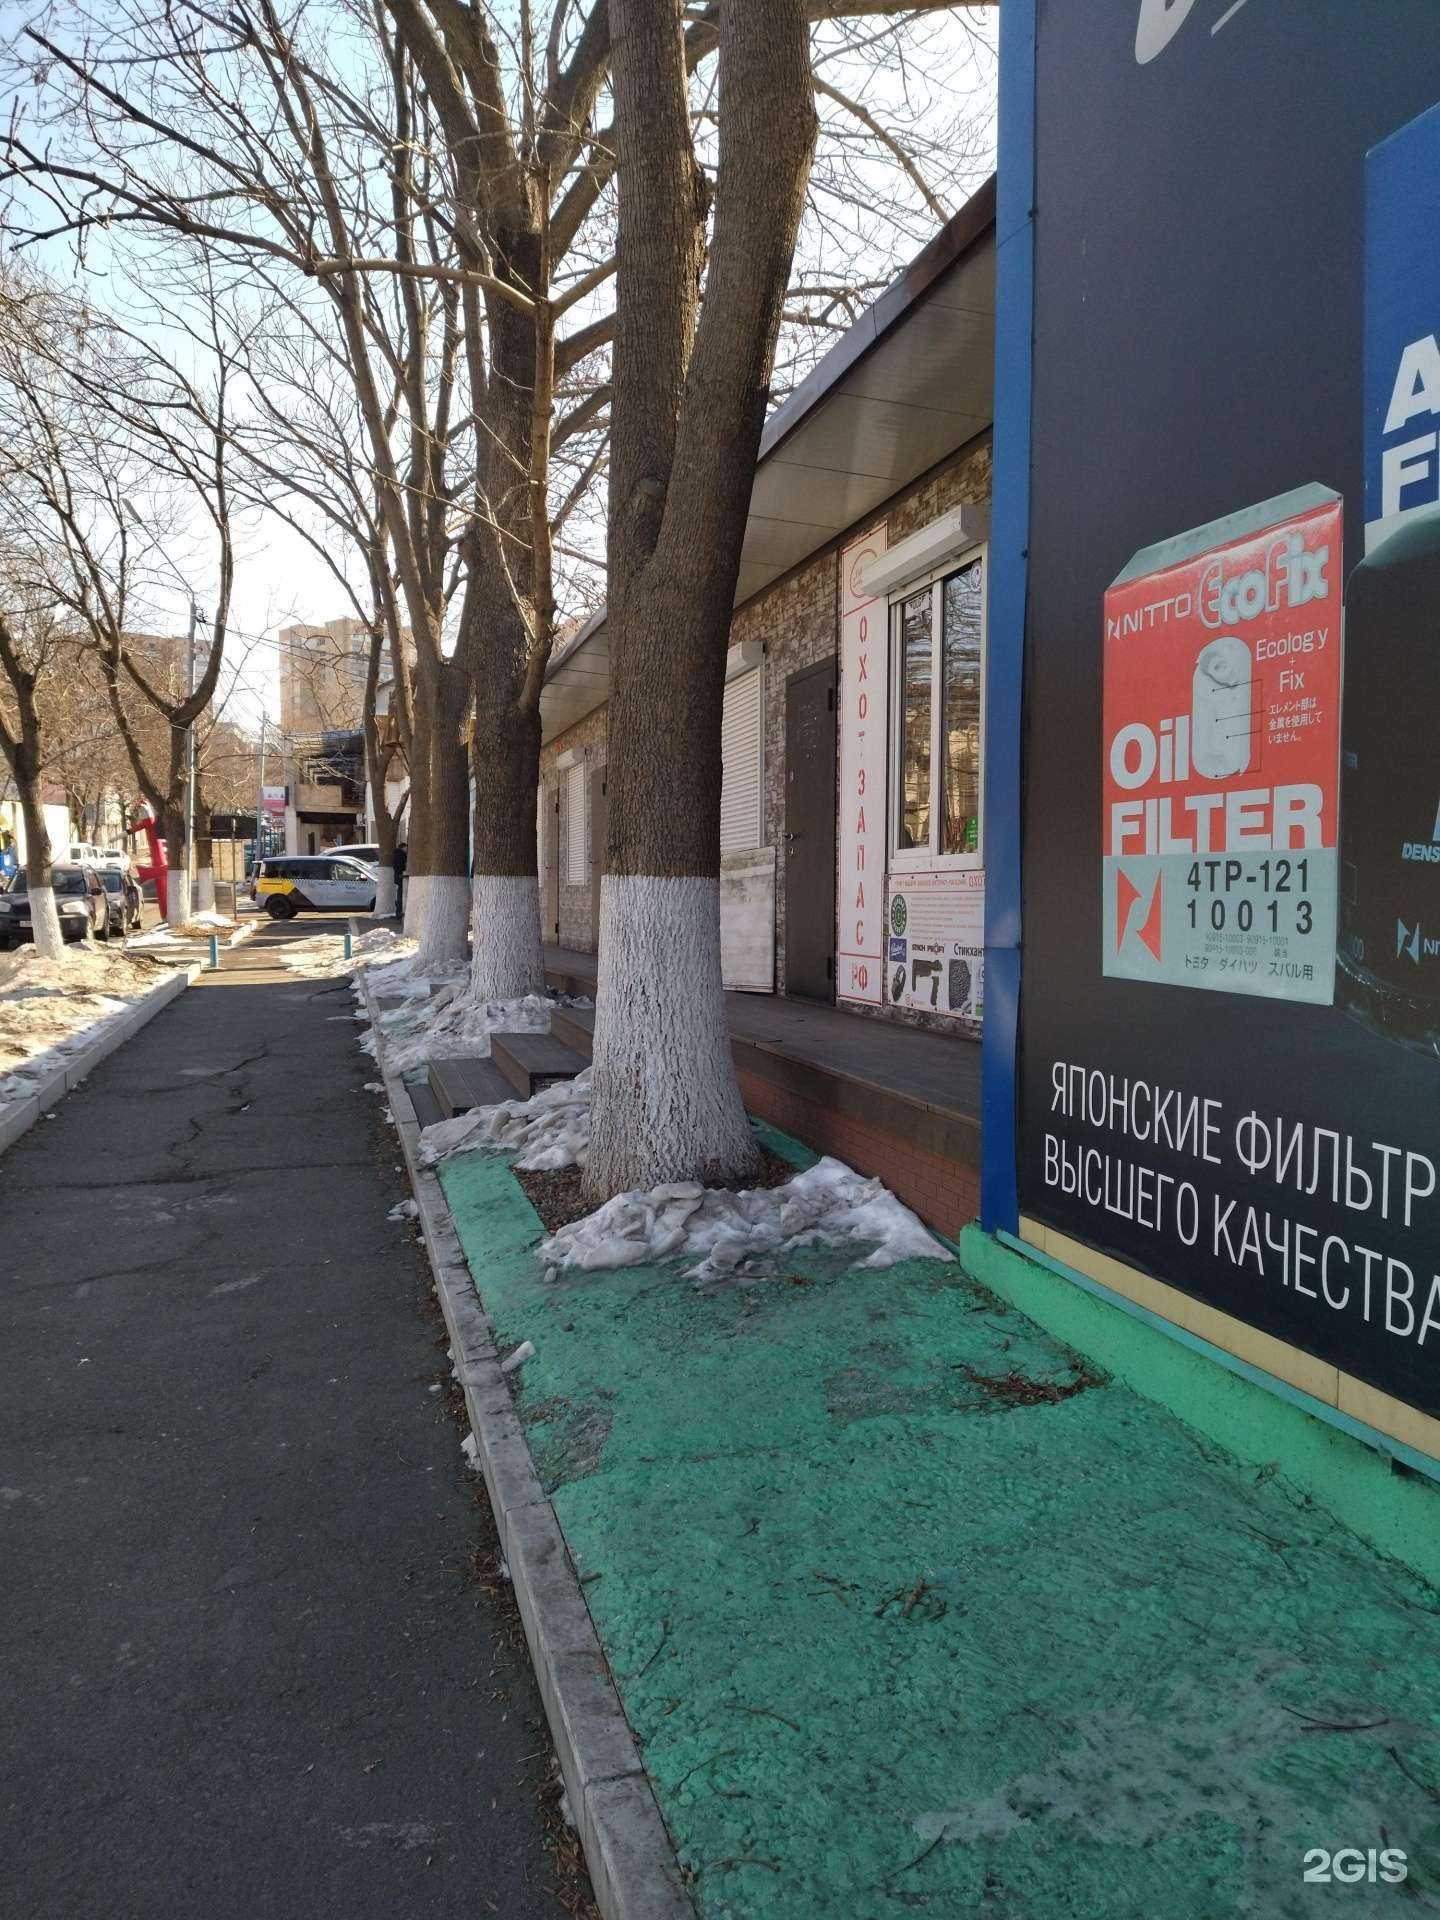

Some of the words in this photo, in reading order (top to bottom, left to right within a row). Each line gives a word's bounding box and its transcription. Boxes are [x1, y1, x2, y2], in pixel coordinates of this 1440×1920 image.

[1123, 593, 1192, 635] NITTO
[1256, 628, 1328, 661] Ecology
[1279, 669, 1305, 692] Fix
[1110, 714, 1190, 790] Oil
[1111, 783, 1325, 856] FILTER
[1187, 858, 1308, 892] 4TP-121
[1051, 1061, 1222, 1165] ЯПОНСКИЕ
[1235, 1110, 1436, 1227] ФИЛЬТР
[1045, 1133, 1199, 1246] ВЫСШЕГО
